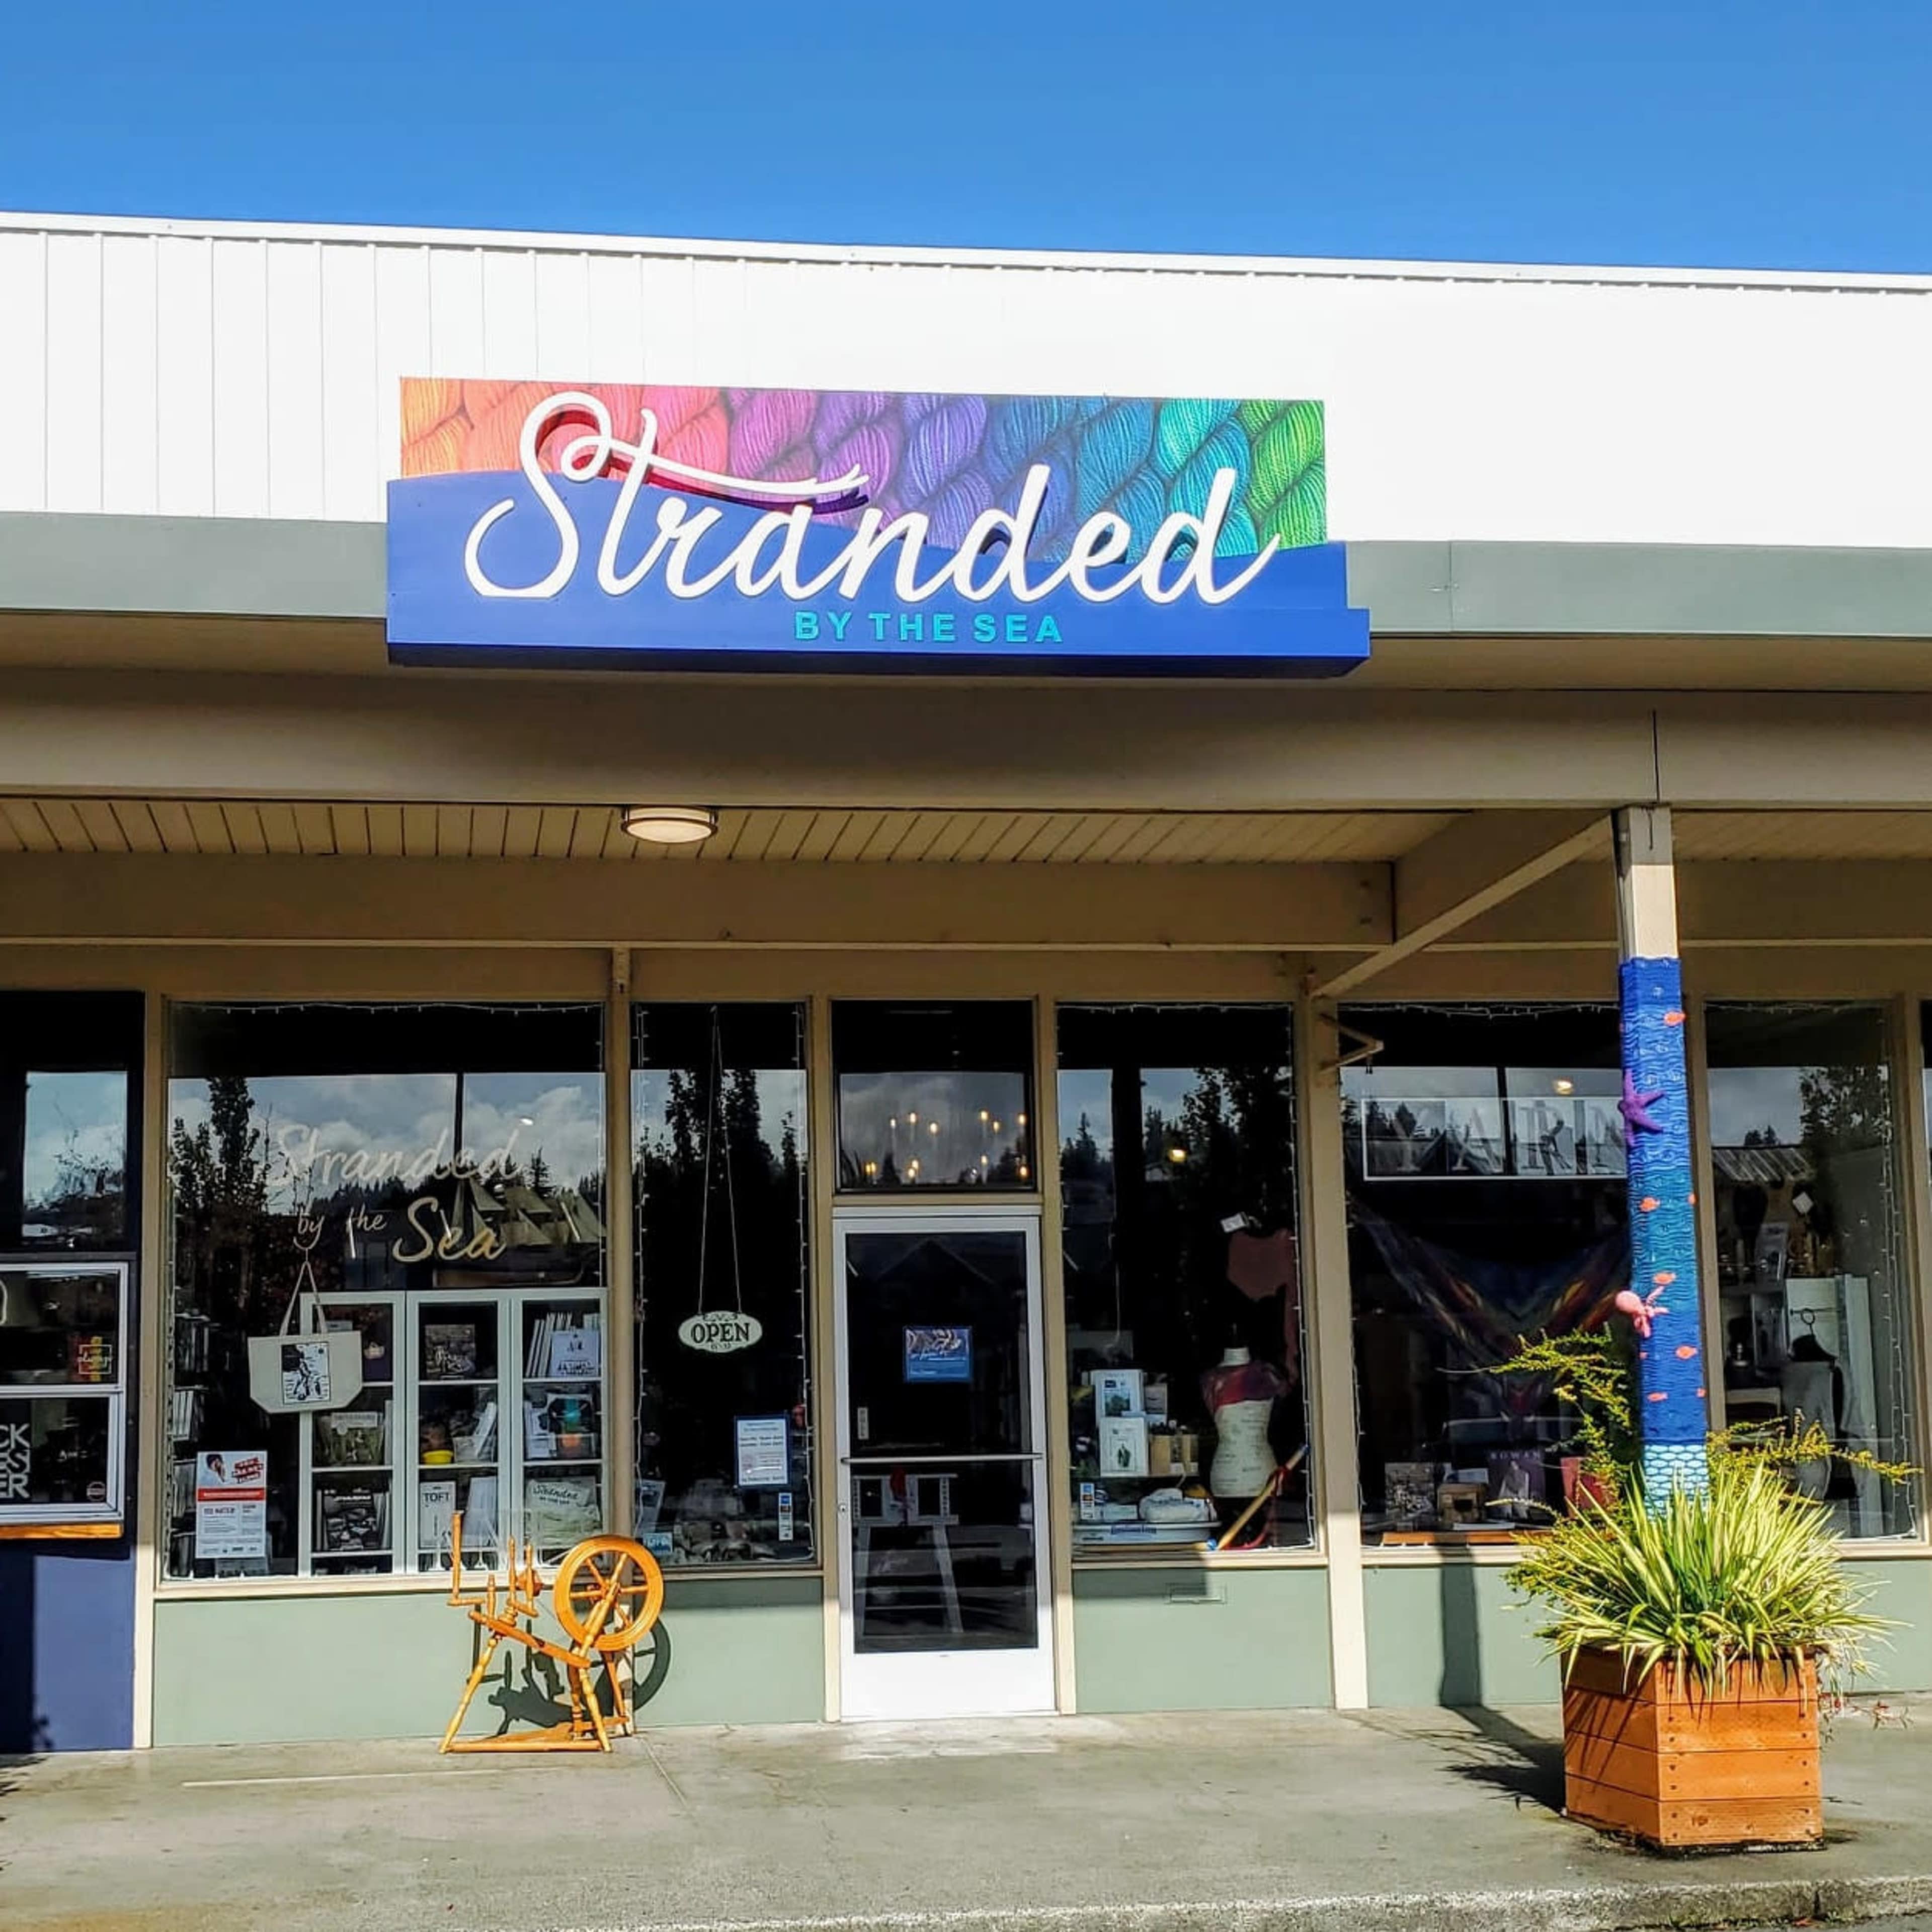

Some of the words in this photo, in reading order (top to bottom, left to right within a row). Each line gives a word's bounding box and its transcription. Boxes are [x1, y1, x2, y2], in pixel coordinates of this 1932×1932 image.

[465, 391, 1282, 605] Stranded
[794, 611, 851, 640] BY
[868, 612, 956, 642] THE
[973, 613, 1063, 643] SEA
[265, 1124, 524, 1186] Stranded
[293, 1203, 325, 1249] by
[346, 1205, 386, 1233] the
[392, 1196, 507, 1262] Sea
[691, 1322, 750, 1343] OPEN
[1491, 1450, 1541, 1460] ROWAN
